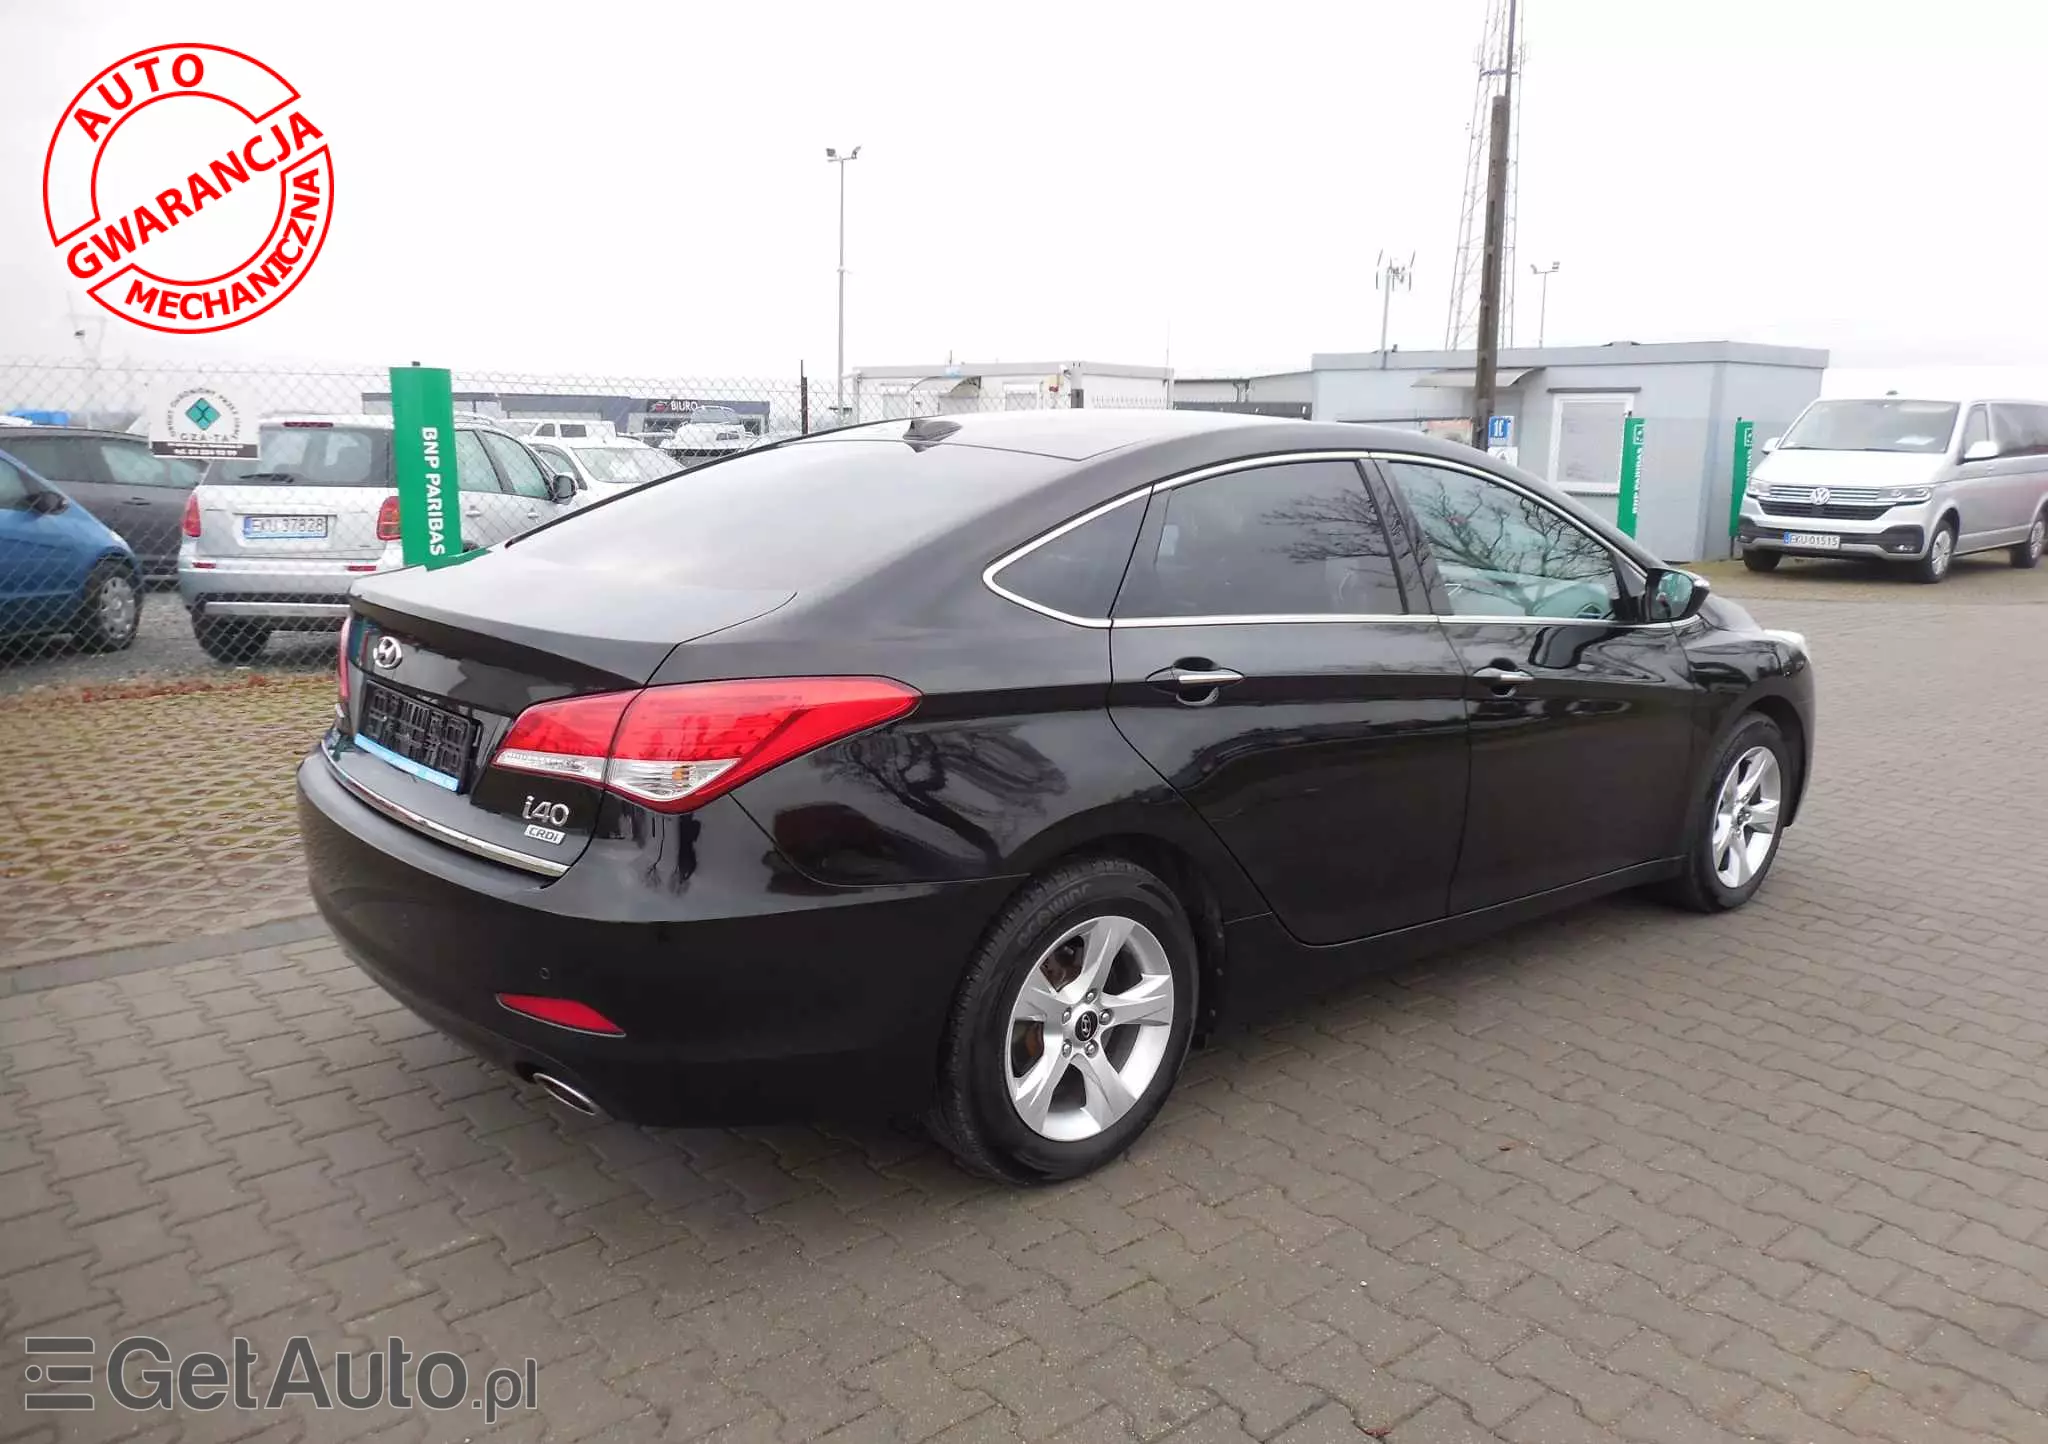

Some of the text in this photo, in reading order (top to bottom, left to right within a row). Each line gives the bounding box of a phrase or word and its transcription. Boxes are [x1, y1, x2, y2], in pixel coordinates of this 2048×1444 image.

[670, 400, 699, 413] BIURO
[422, 427, 446, 556] BNP PARIBAS
[522, 795, 570, 827] i40
[529, 827, 559, 841] CRDI
